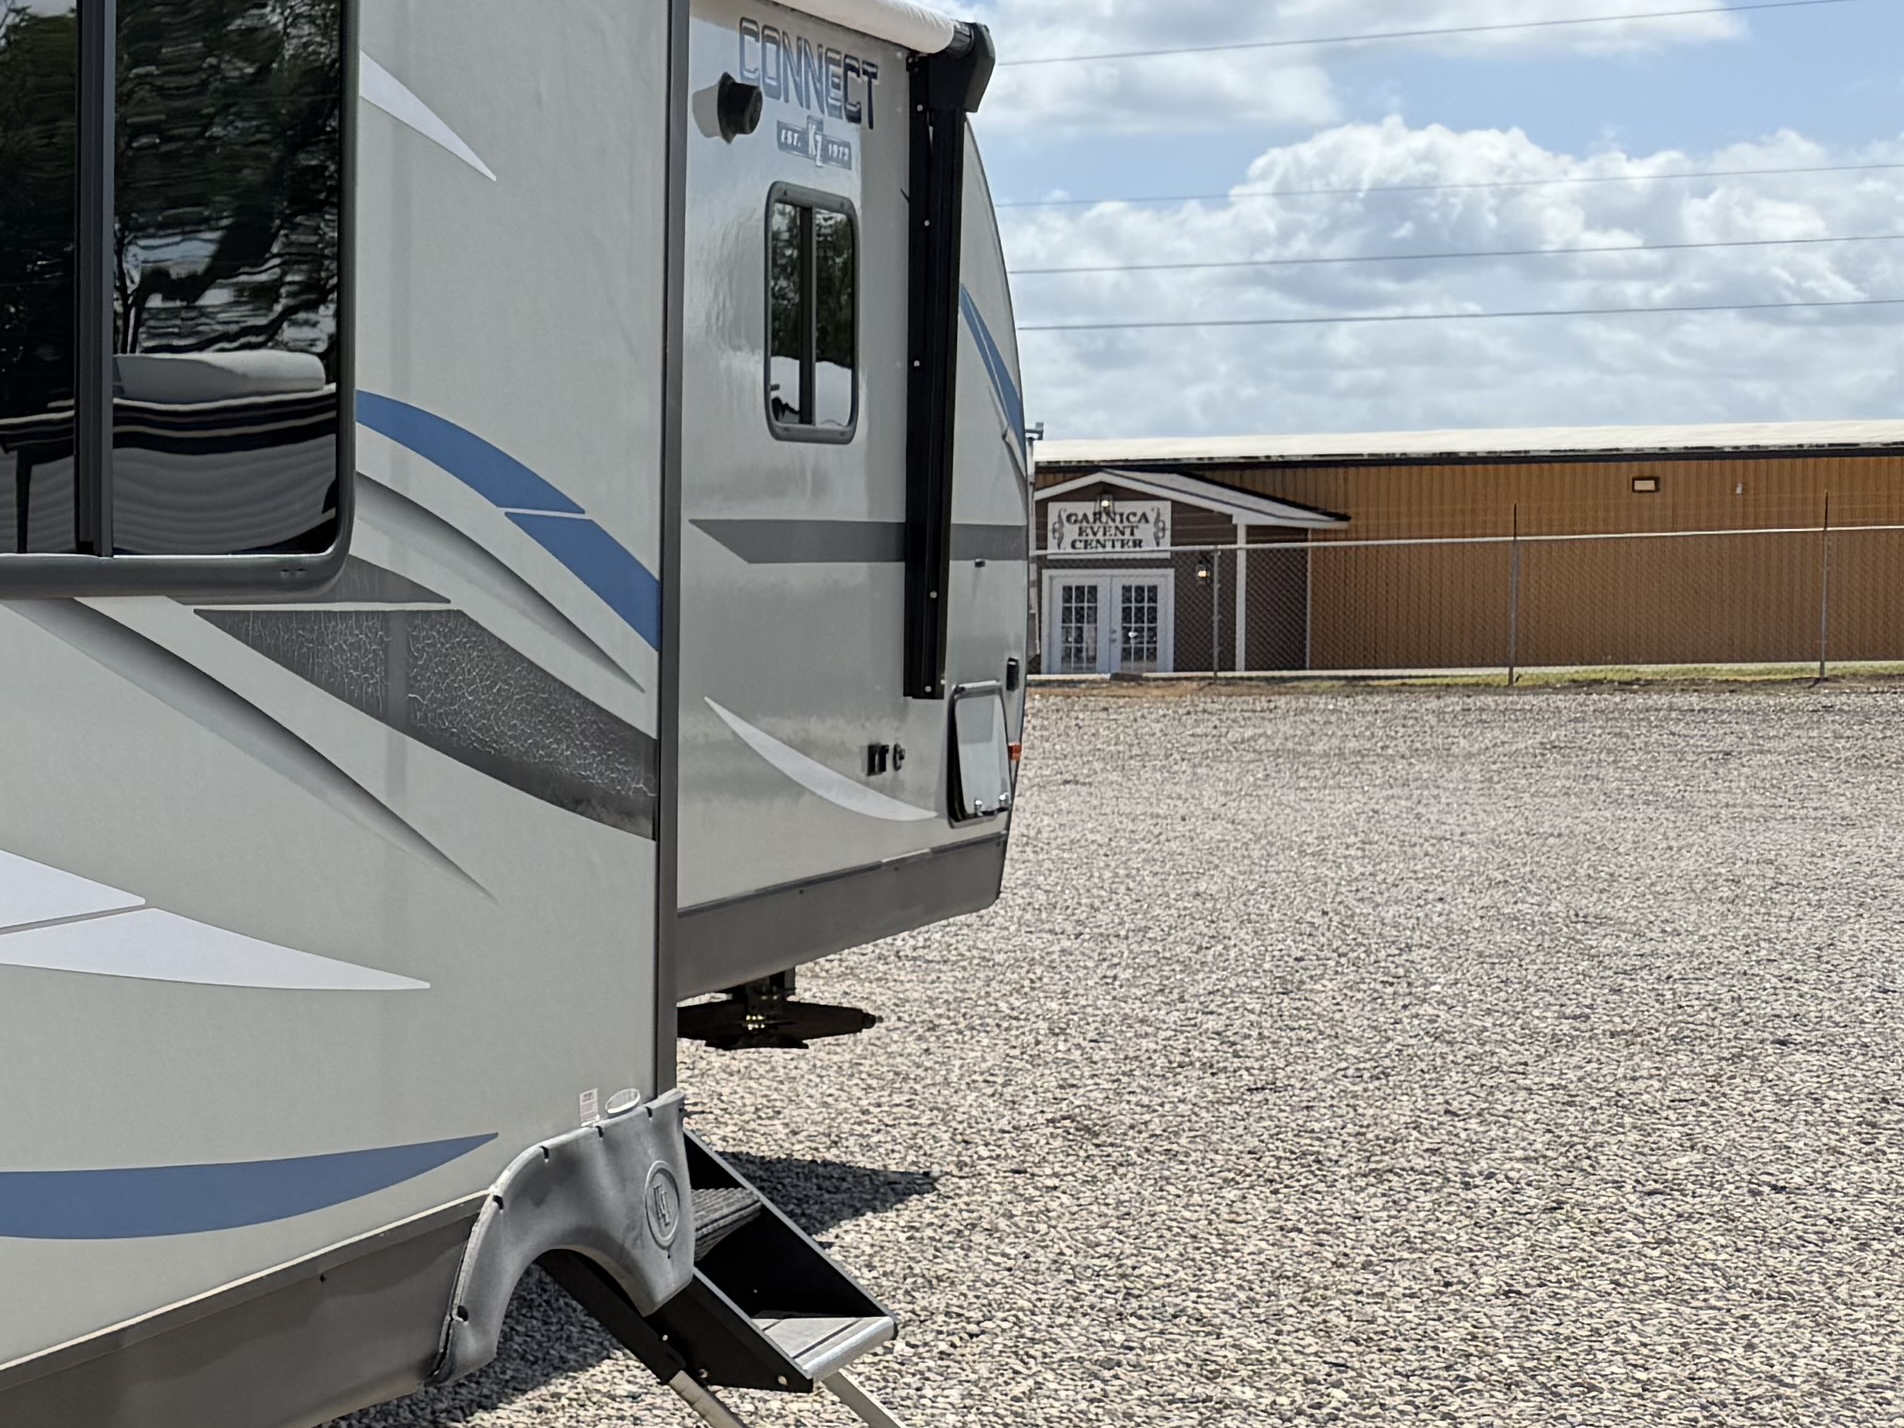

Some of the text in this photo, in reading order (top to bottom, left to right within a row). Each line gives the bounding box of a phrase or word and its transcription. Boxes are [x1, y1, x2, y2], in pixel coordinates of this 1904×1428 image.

[738, 16, 880, 130] CONNECT
[1065, 512, 1150, 525] GARNICA
[1077, 525, 1139, 537] EVENT
[1070, 538, 1144, 550] CENTER
